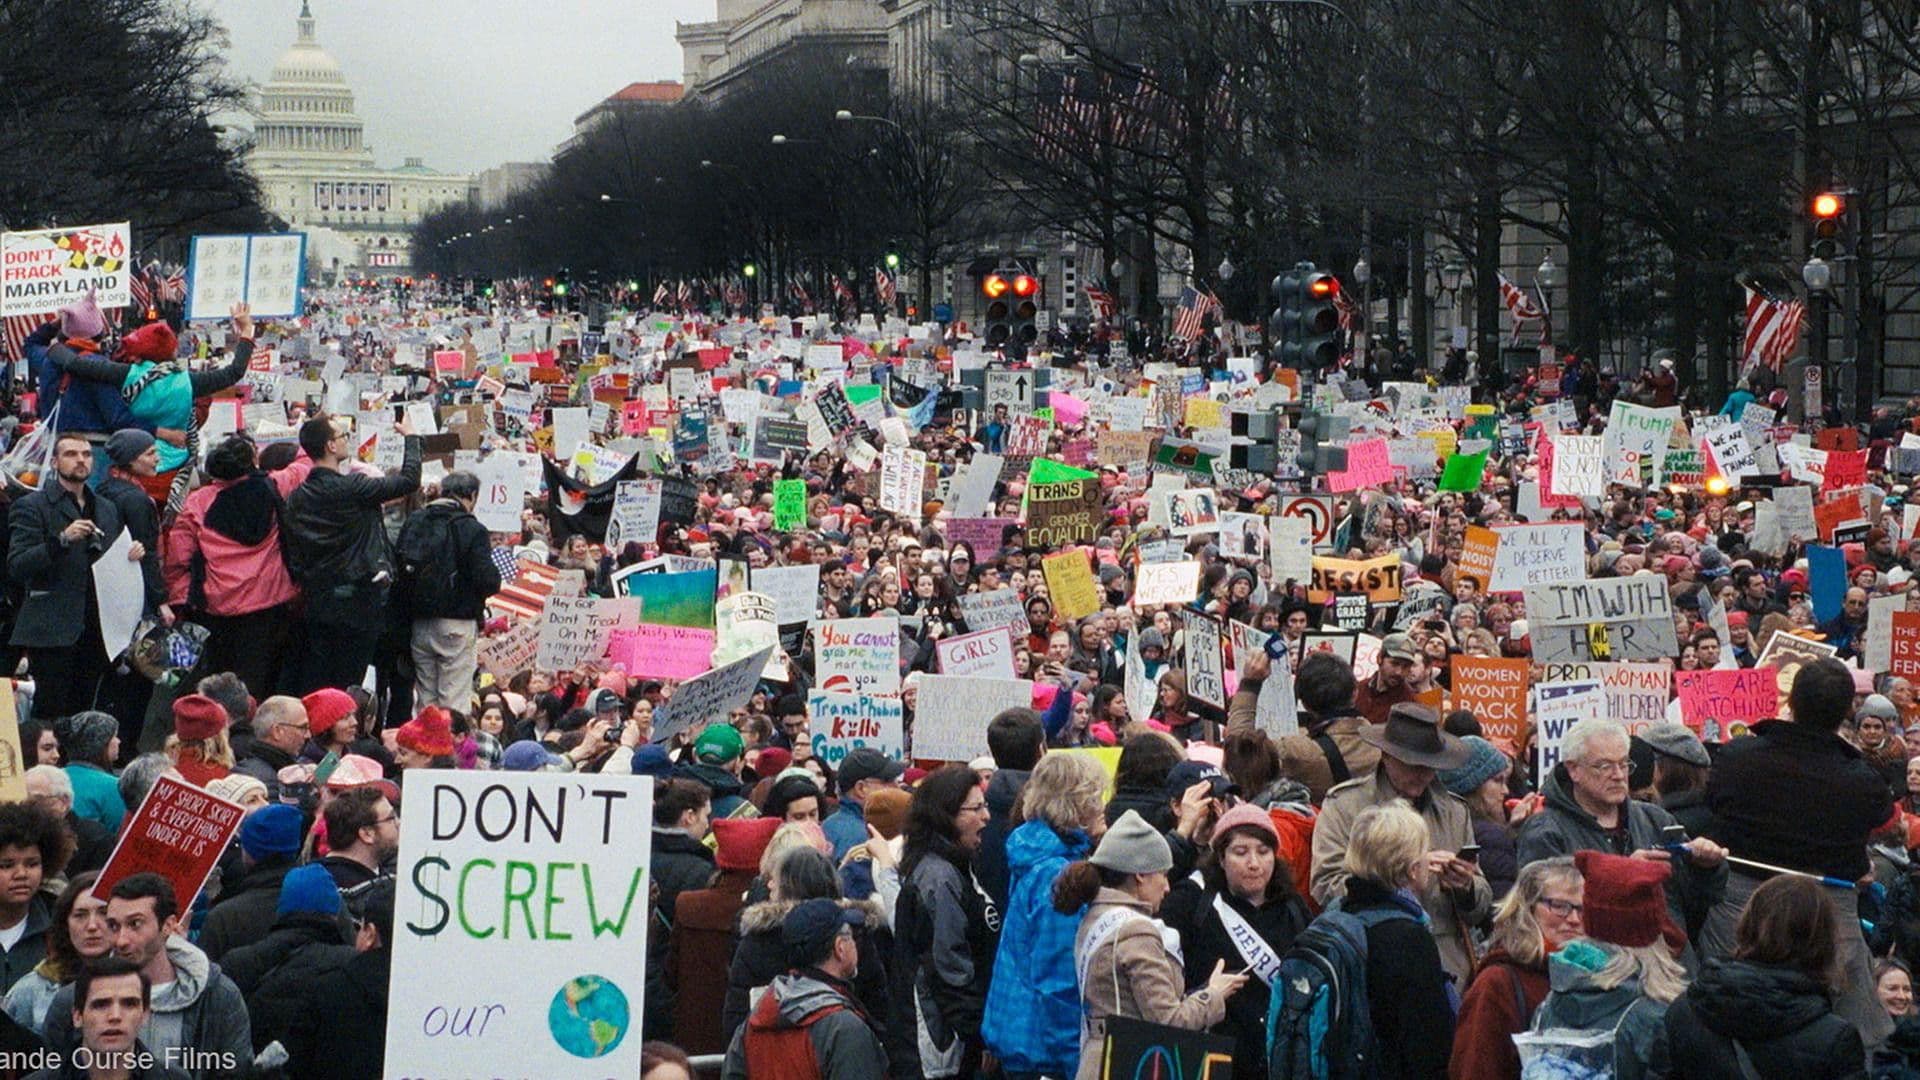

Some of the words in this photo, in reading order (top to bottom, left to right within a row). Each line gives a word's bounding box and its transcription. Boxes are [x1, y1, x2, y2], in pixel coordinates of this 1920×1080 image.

[5, 249, 56, 264] DON'T
[5, 264, 62, 280] FRACK
[5, 275, 117, 298] MARYLAND
[1710, 433, 1726, 447] WE
[1729, 430, 1742, 440] ARE
[1722, 444, 1740, 458] NOT
[1560, 456, 1571, 474] IS
[1576, 456, 1600, 475] NOT
[1722, 454, 1755, 477] THINGS
[491, 485, 507, 504] IS
[1032, 482, 1080, 499] TRANS
[1050, 512, 1090, 527] GENDER
[1029, 523, 1099, 547] EQUALITY
[1500, 530, 1516, 546] WE
[1528, 530, 1548, 546] ALL
[1461, 550, 1493, 567] NOISY
[1514, 547, 1567, 567] DESERVE
[1145, 566, 1179, 585] YES
[1309, 564, 1398, 591] RESIST
[552, 597, 569, 610] Hey
[575, 598, 596, 609] GOP
[1598, 583, 1667, 618] WITH
[586, 613, 621, 626] Tread
[1336, 606, 1367, 618] GRABS
[559, 629, 576, 640] On
[822, 624, 849, 647] You
[854, 632, 897, 647] cannot
[1895, 627, 1918, 637] THE
[822, 647, 846, 663] grab
[951, 638, 999, 663] GIRLS
[1895, 640, 1909, 654] IS
[855, 675, 877, 691] you
[1458, 666, 1521, 682] WOMEN
[1600, 667, 1667, 689] WOMAN
[1690, 673, 1717, 696] WE
[1731, 671, 1772, 696] ARE
[1459, 684, 1520, 698] WON'T
[1460, 702, 1519, 720] BACK
[1605, 693, 1666, 720] HILDREN
[832, 716, 881, 739] Kills
[155, 783, 178, 801] MY
[174, 790, 209, 814] SHORT
[206, 803, 237, 827] SKIRT
[432, 784, 628, 844] DON'T
[150, 801, 162, 818] &
[161, 807, 224, 842] EVERYTHING
[145, 821, 181, 847] UNDER
[180, 834, 194, 851] IT
[192, 840, 207, 856] IS
[1232, 924, 1271, 971] HEAR
[424, 1003, 506, 1038] our
